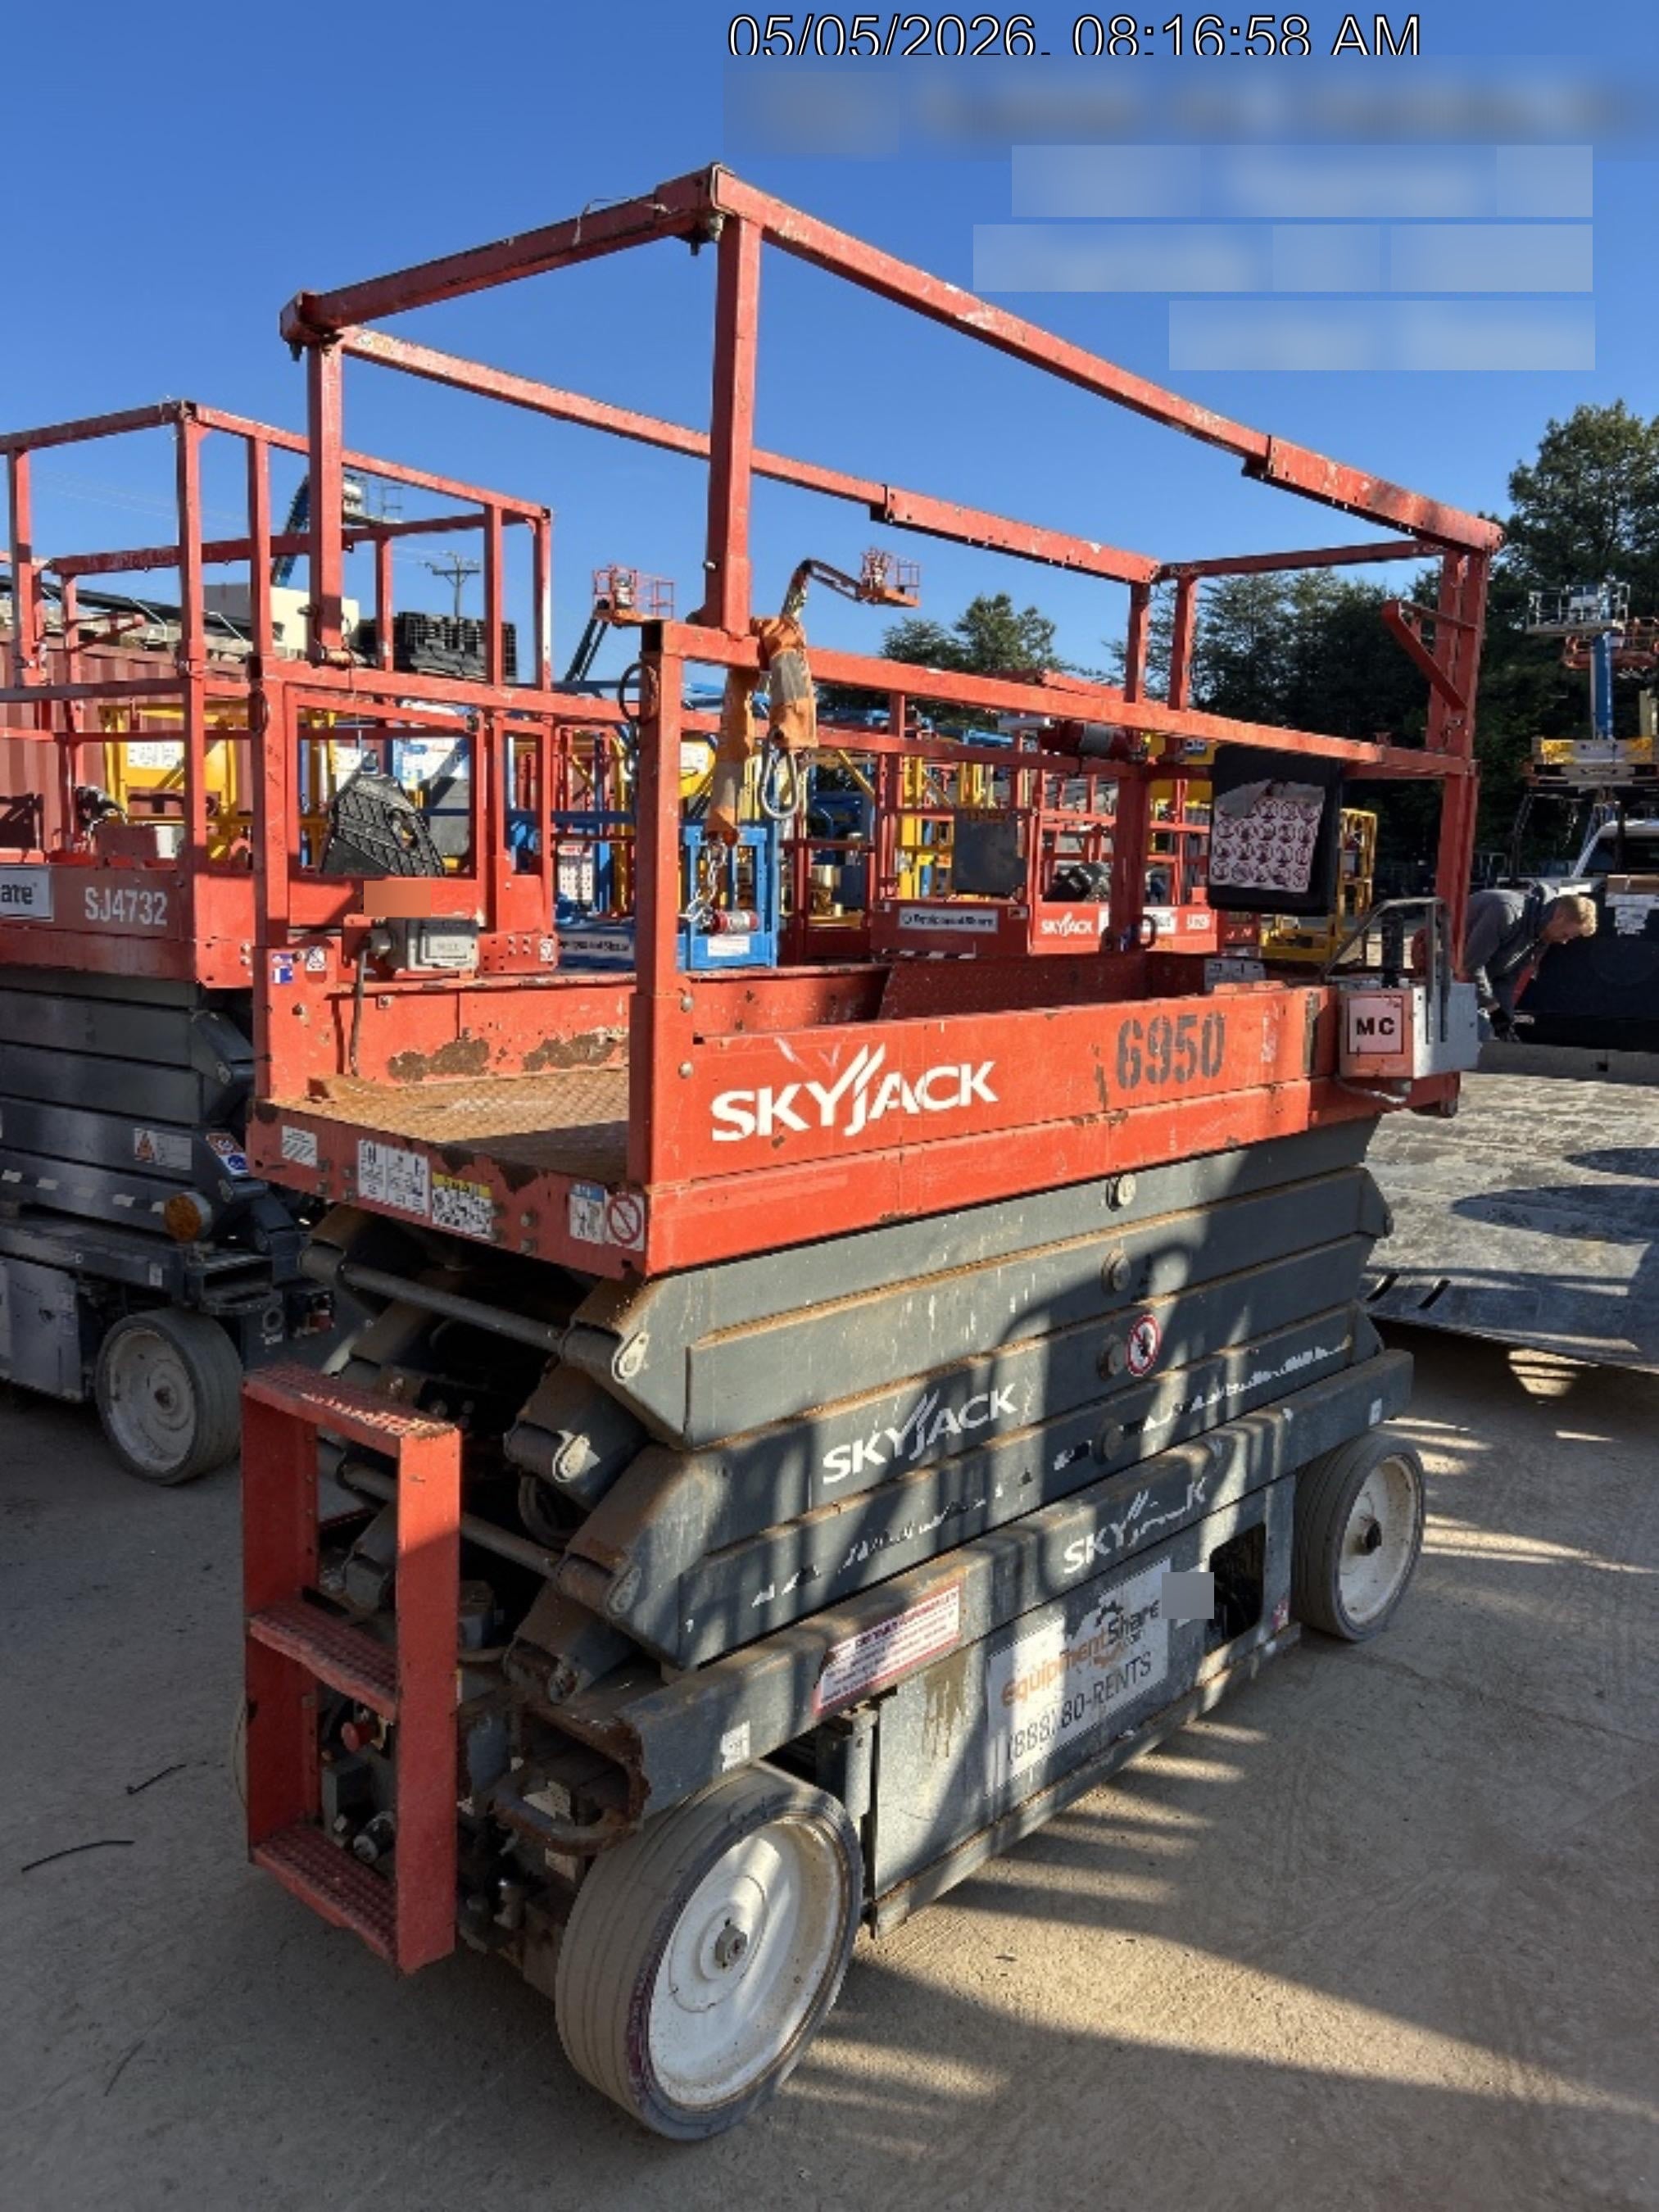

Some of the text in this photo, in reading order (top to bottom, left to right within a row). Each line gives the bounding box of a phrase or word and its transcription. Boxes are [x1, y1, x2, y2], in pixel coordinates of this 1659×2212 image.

[84, 886, 168, 925] SJ4732
[1041, 912, 1092, 936] SKYJACK
[709, 1042, 999, 1141] SKYJACK
[1117, 1010, 1225, 1090] 6950
[823, 1383, 1018, 1484] SKYJACK
[1063, 1476, 1206, 1574] SKYJK
